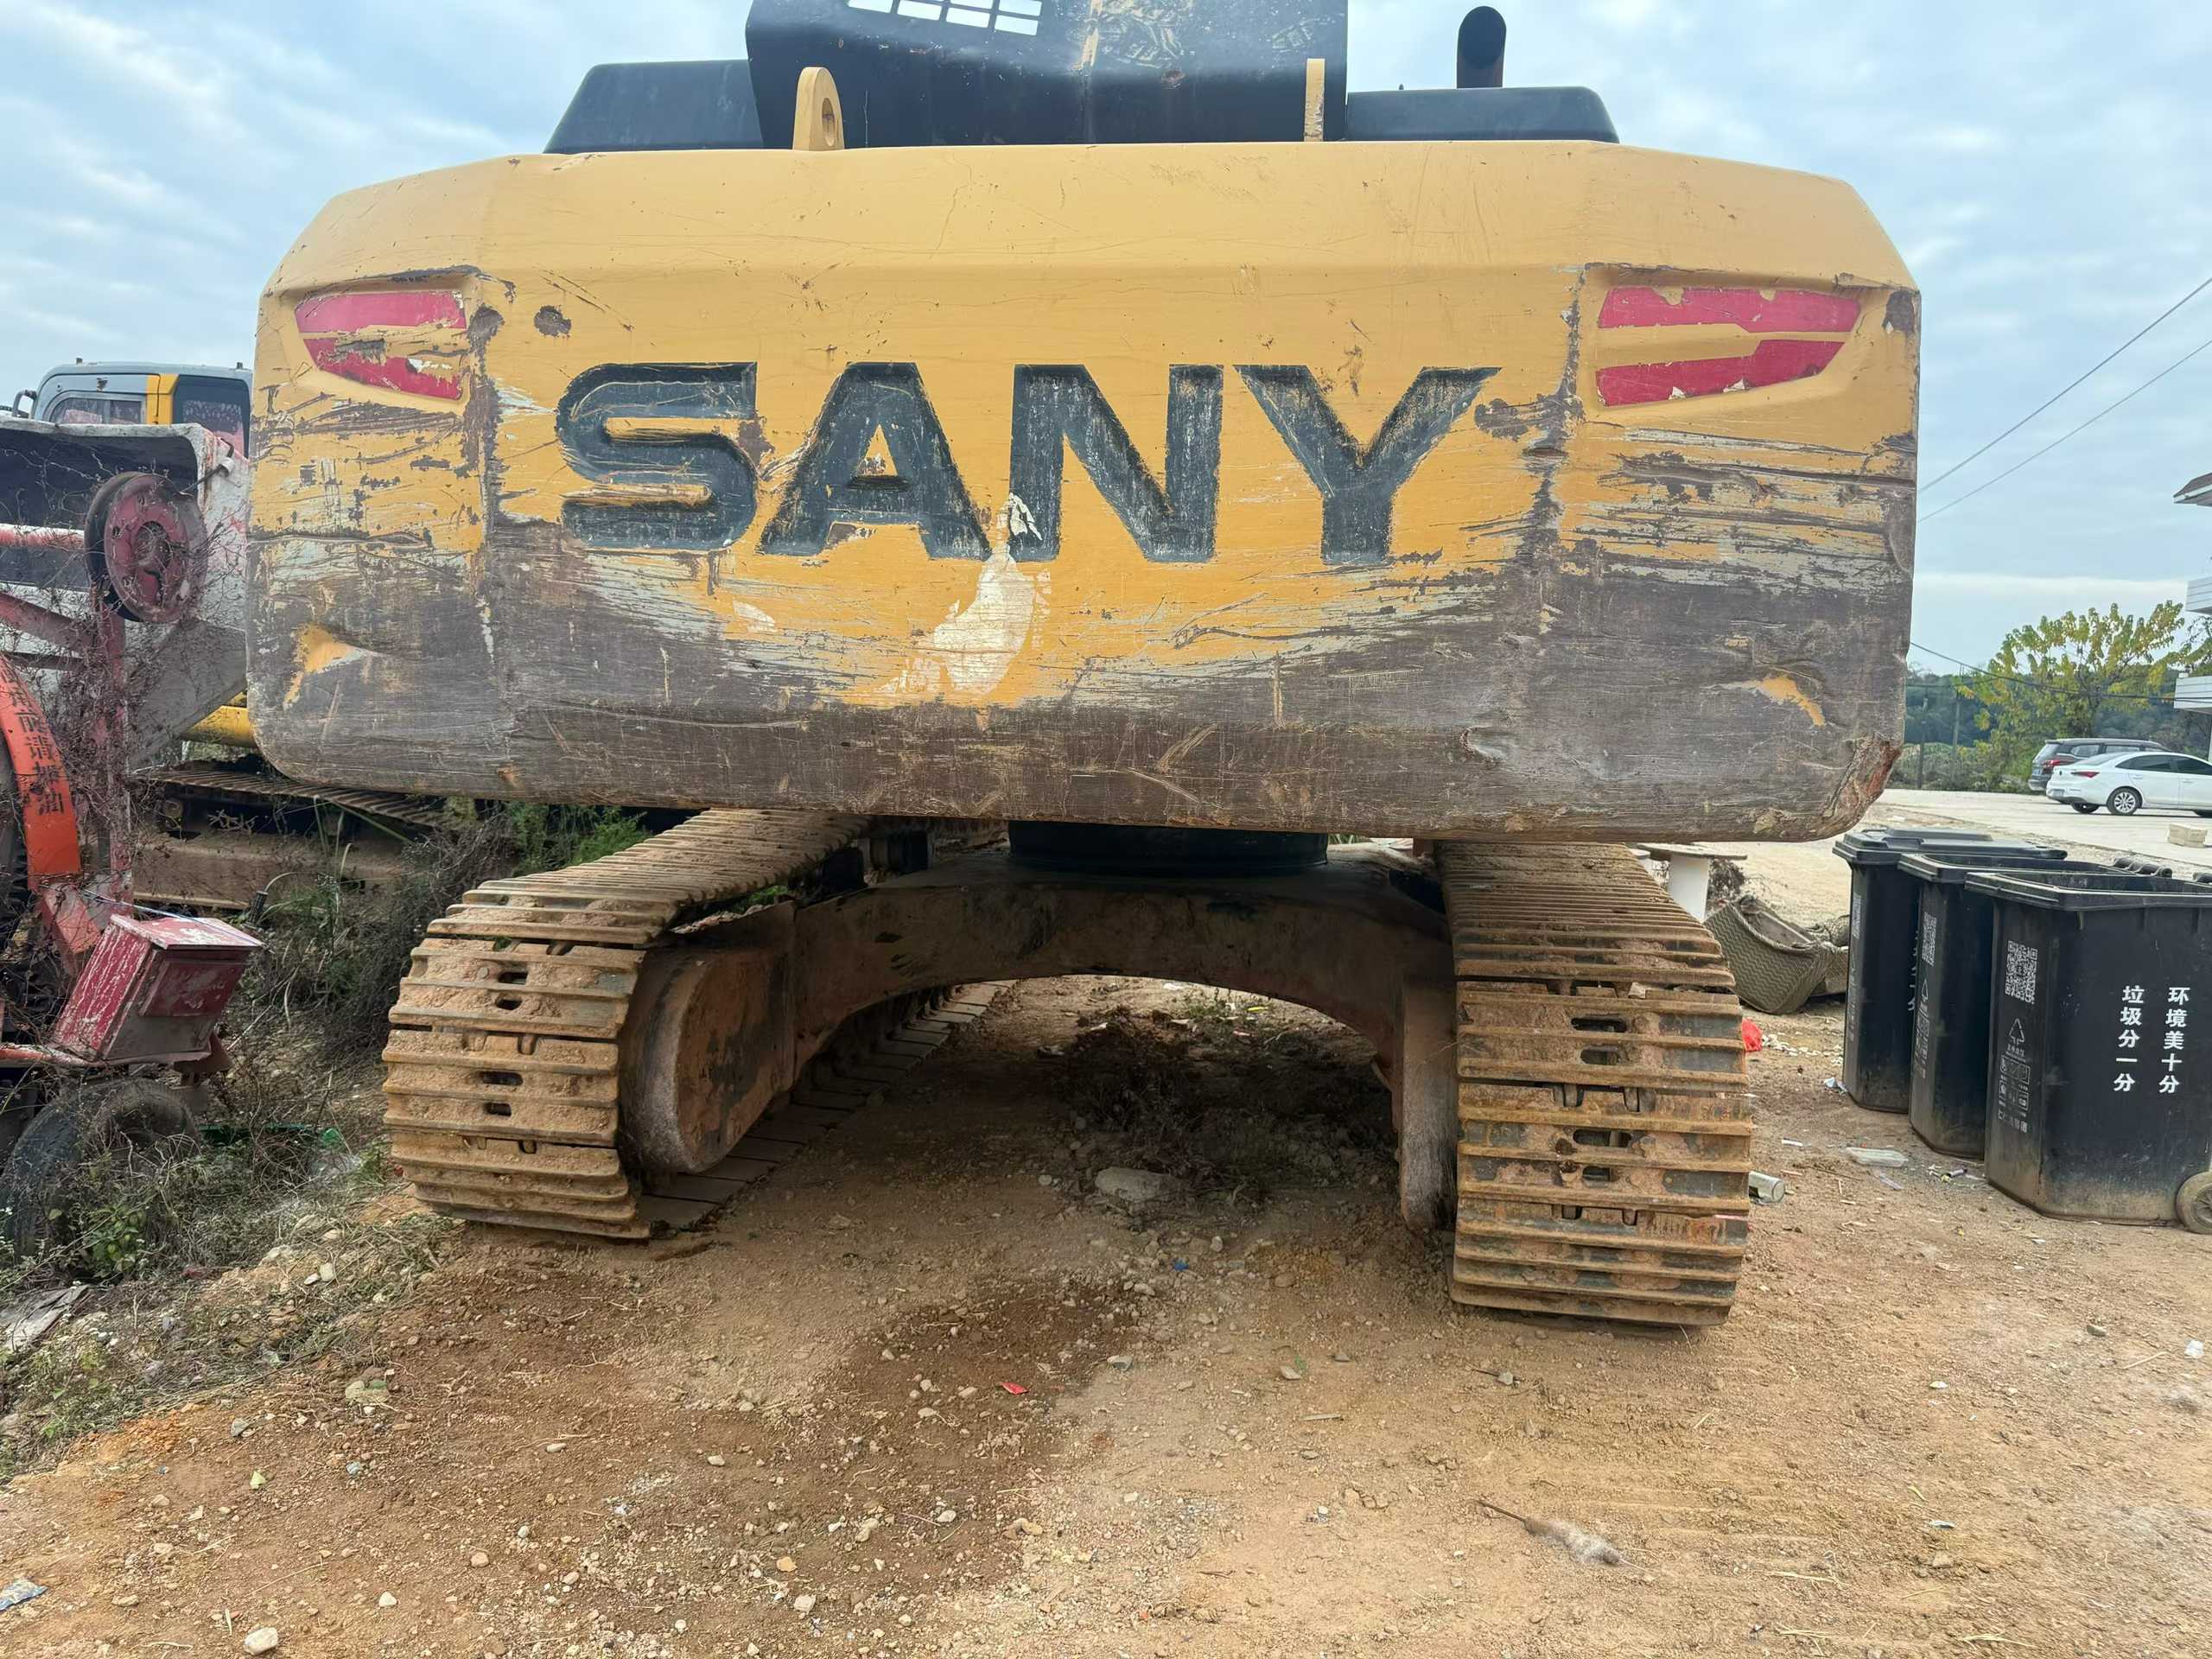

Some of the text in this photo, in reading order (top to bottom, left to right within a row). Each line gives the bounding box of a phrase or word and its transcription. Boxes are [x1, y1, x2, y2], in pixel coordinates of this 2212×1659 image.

[556, 361, 1503, 565] SANY
[2113, 985, 2145, 1091] 垃圾分一分
[2158, 987, 2190, 1093] 环境美十分
